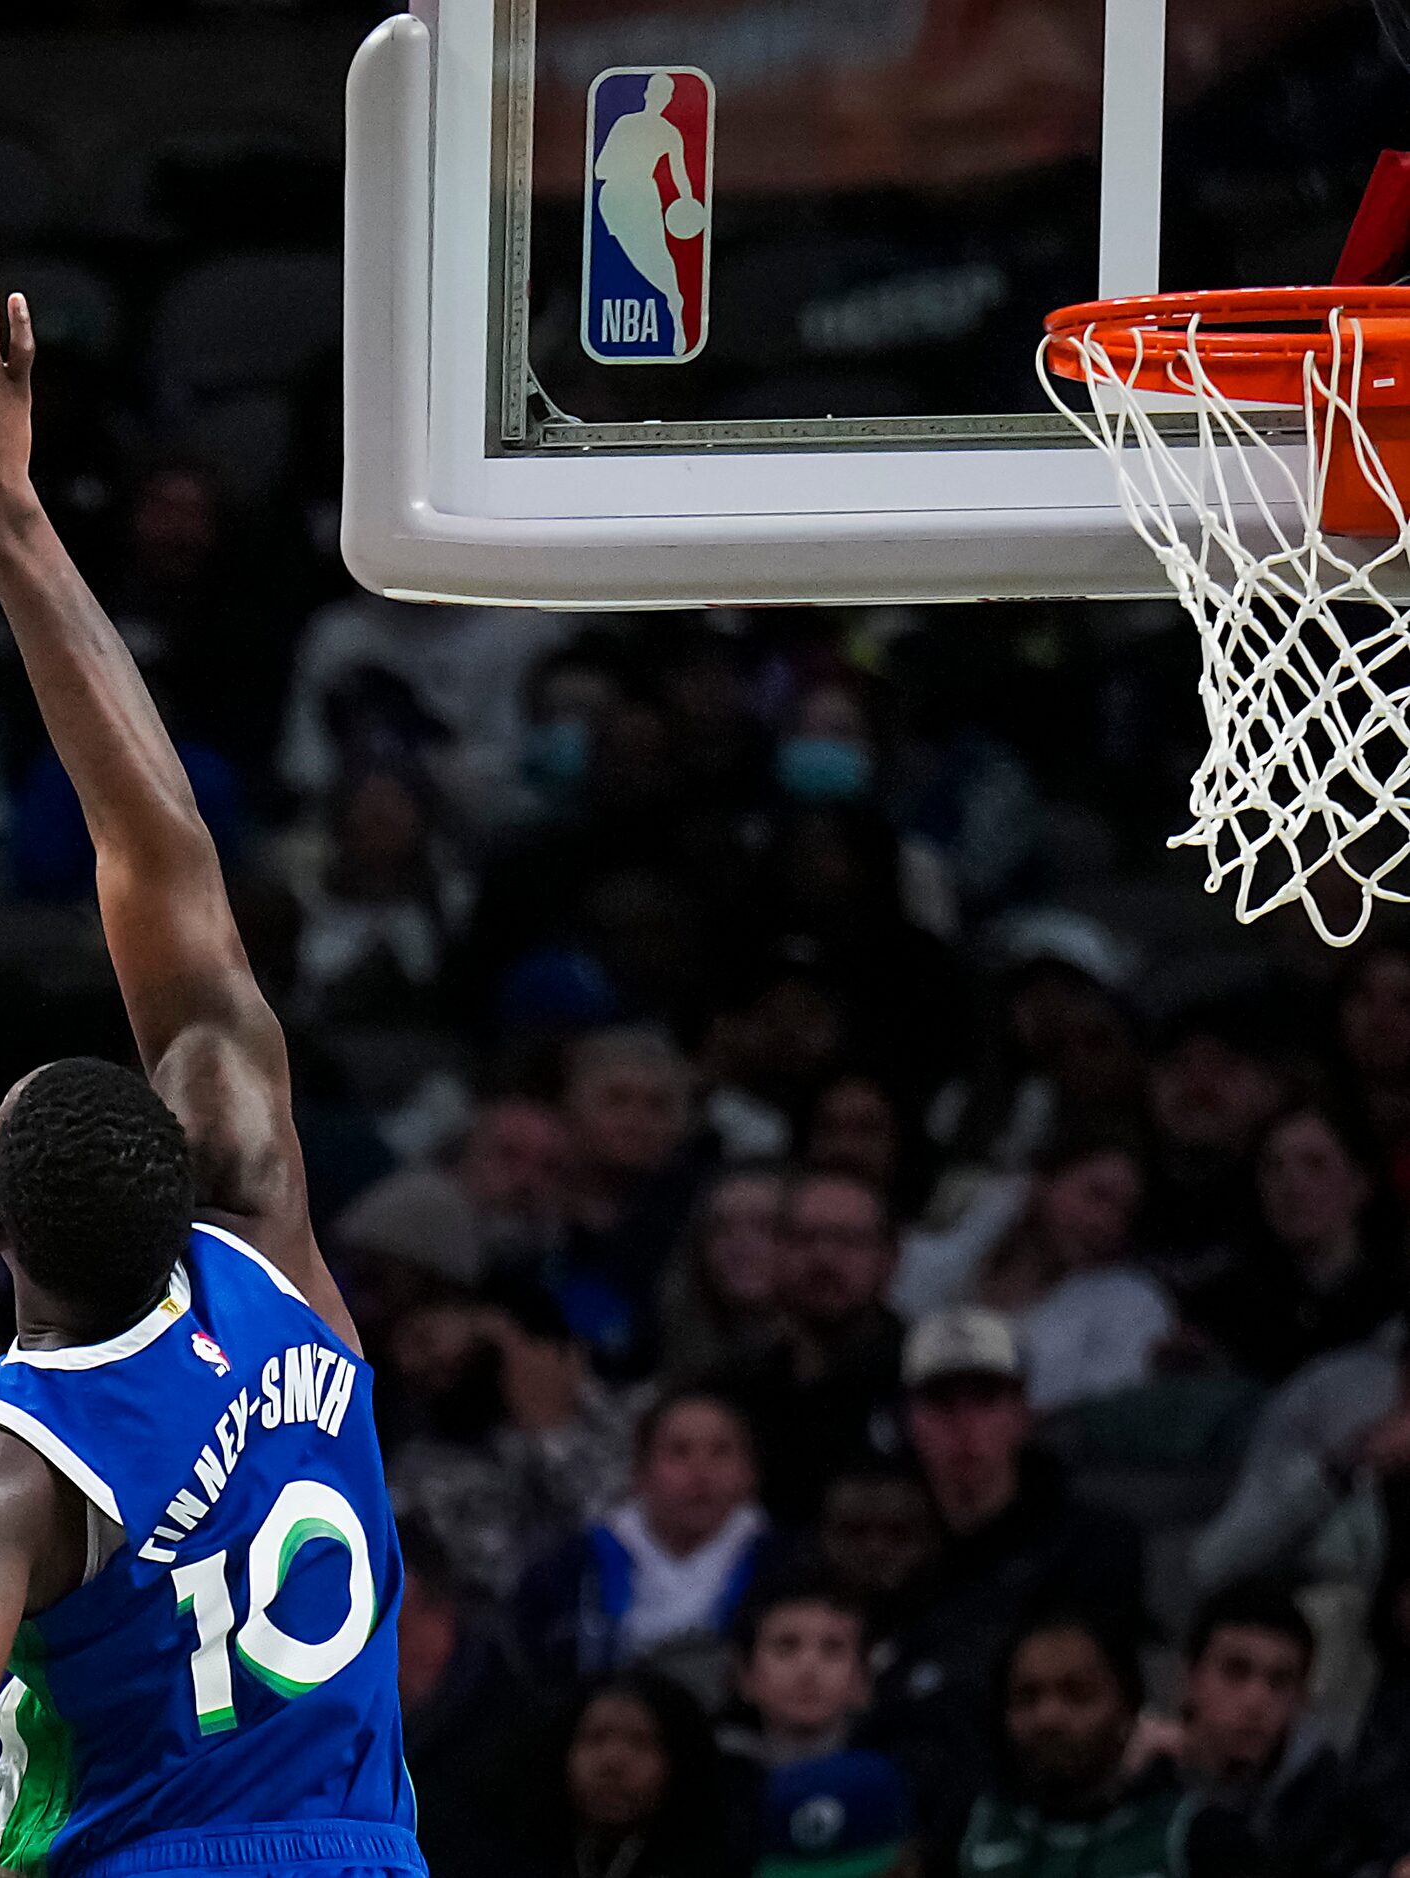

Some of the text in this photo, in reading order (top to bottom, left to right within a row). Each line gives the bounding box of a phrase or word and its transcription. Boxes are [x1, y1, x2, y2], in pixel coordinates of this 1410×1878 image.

[601, 298, 659, 343] NBA
[138, 1342, 357, 1563] FINNEY-SMTH
[171, 1480, 378, 1736] 10
